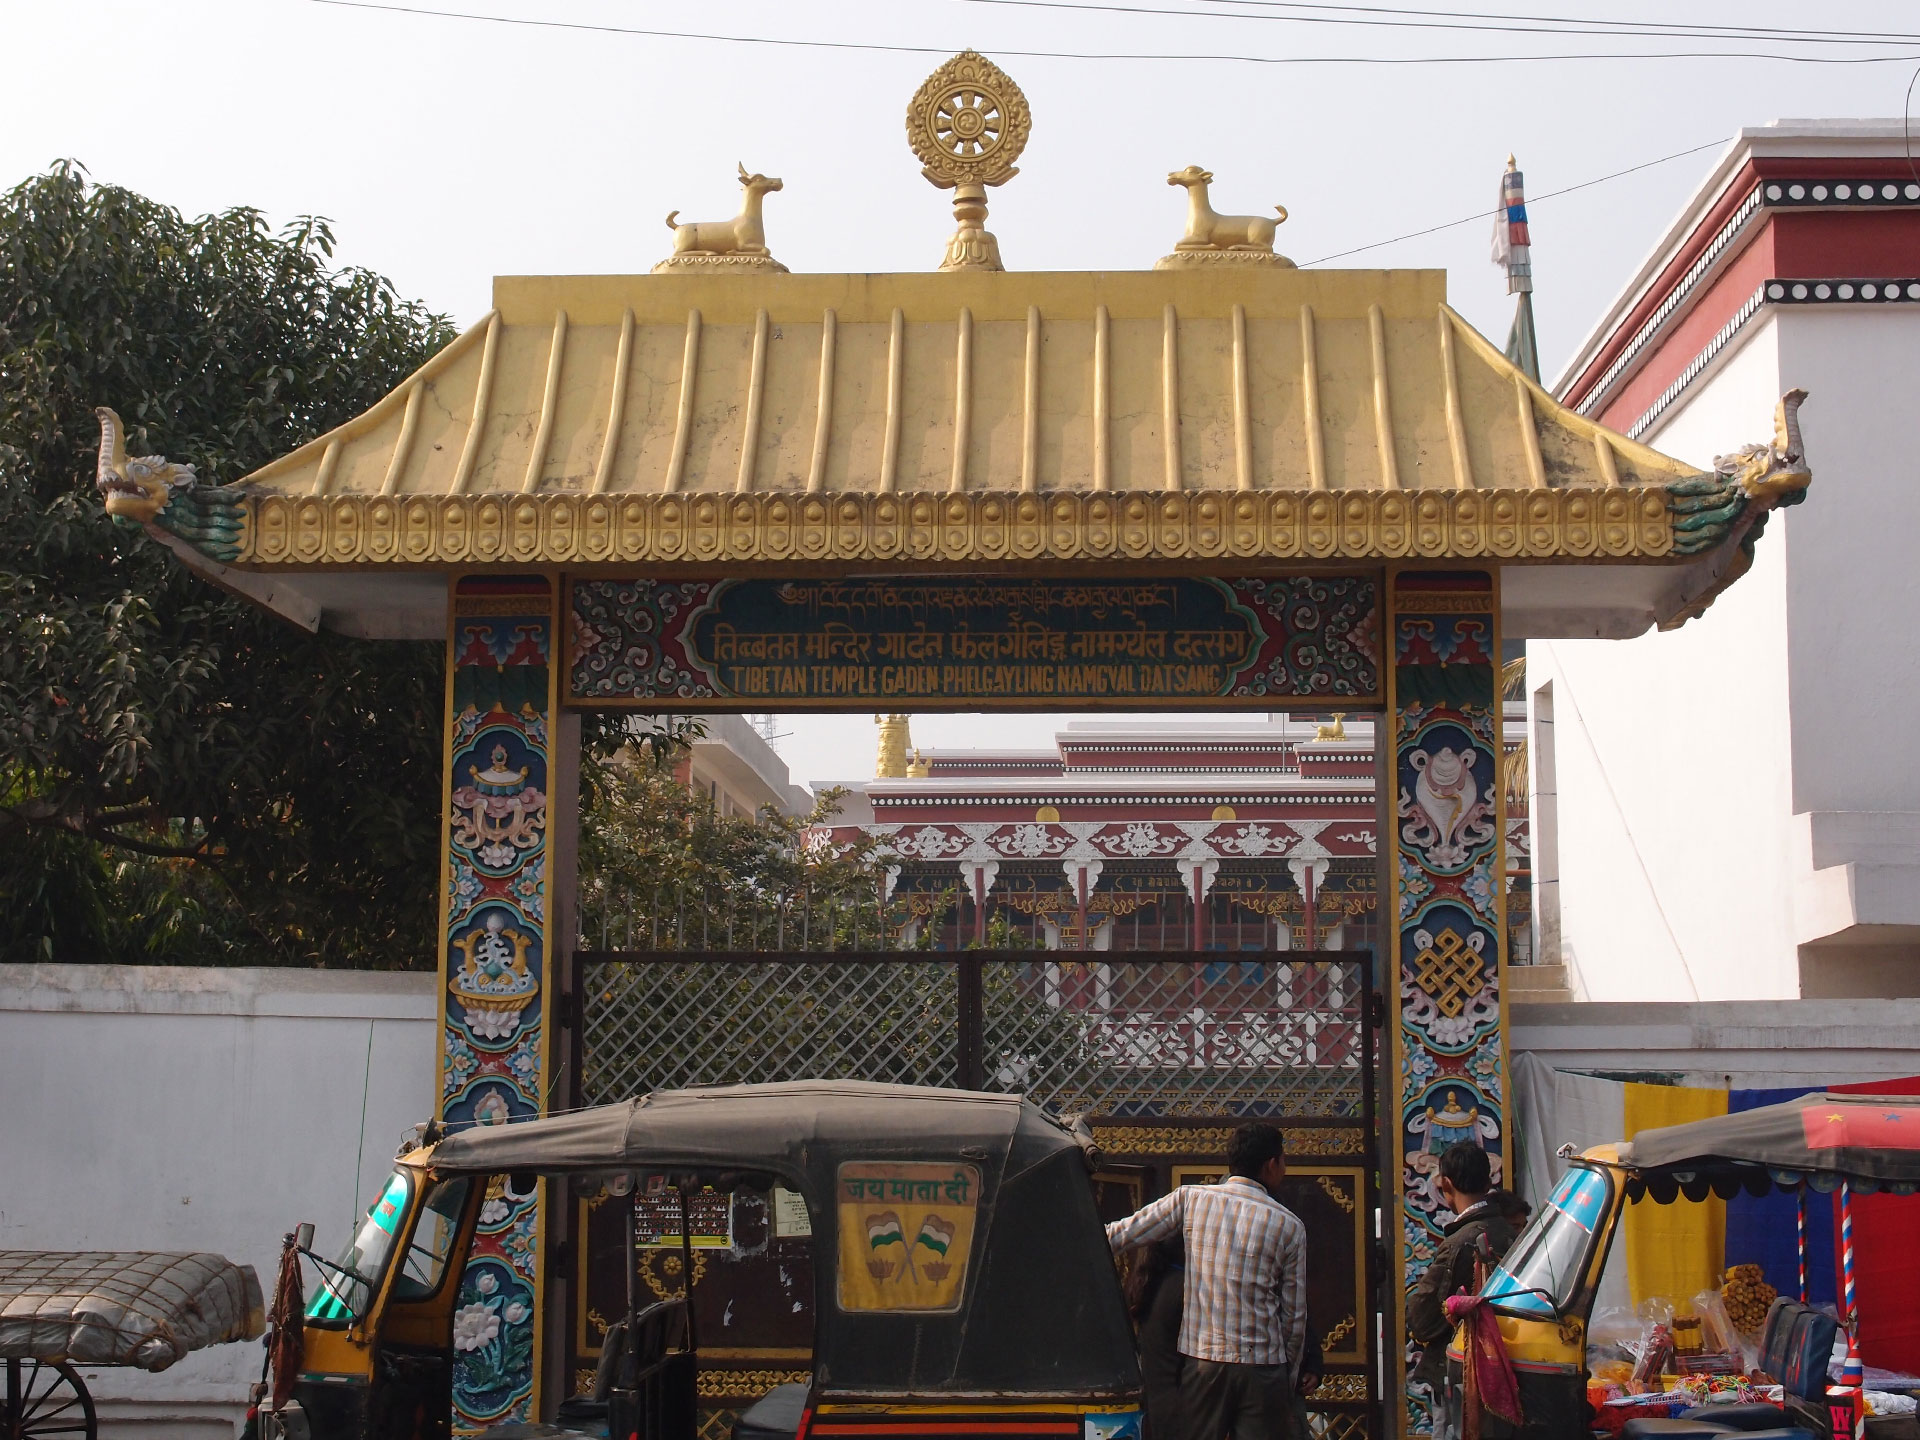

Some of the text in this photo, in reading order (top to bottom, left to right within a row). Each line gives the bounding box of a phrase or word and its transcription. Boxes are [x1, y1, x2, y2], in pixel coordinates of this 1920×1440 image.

[805, 621, 872, 663] मन्दिर
[731, 666, 806, 693] TIBETAN
[811, 666, 876, 693] TEMPLE
[881, 665, 939, 693] GADEN
[943, 665, 1055, 693] PHELGAYLING
[1140, 665, 1220, 693] DATSANG
[842, 1172, 970, 1204] जय माता दी
